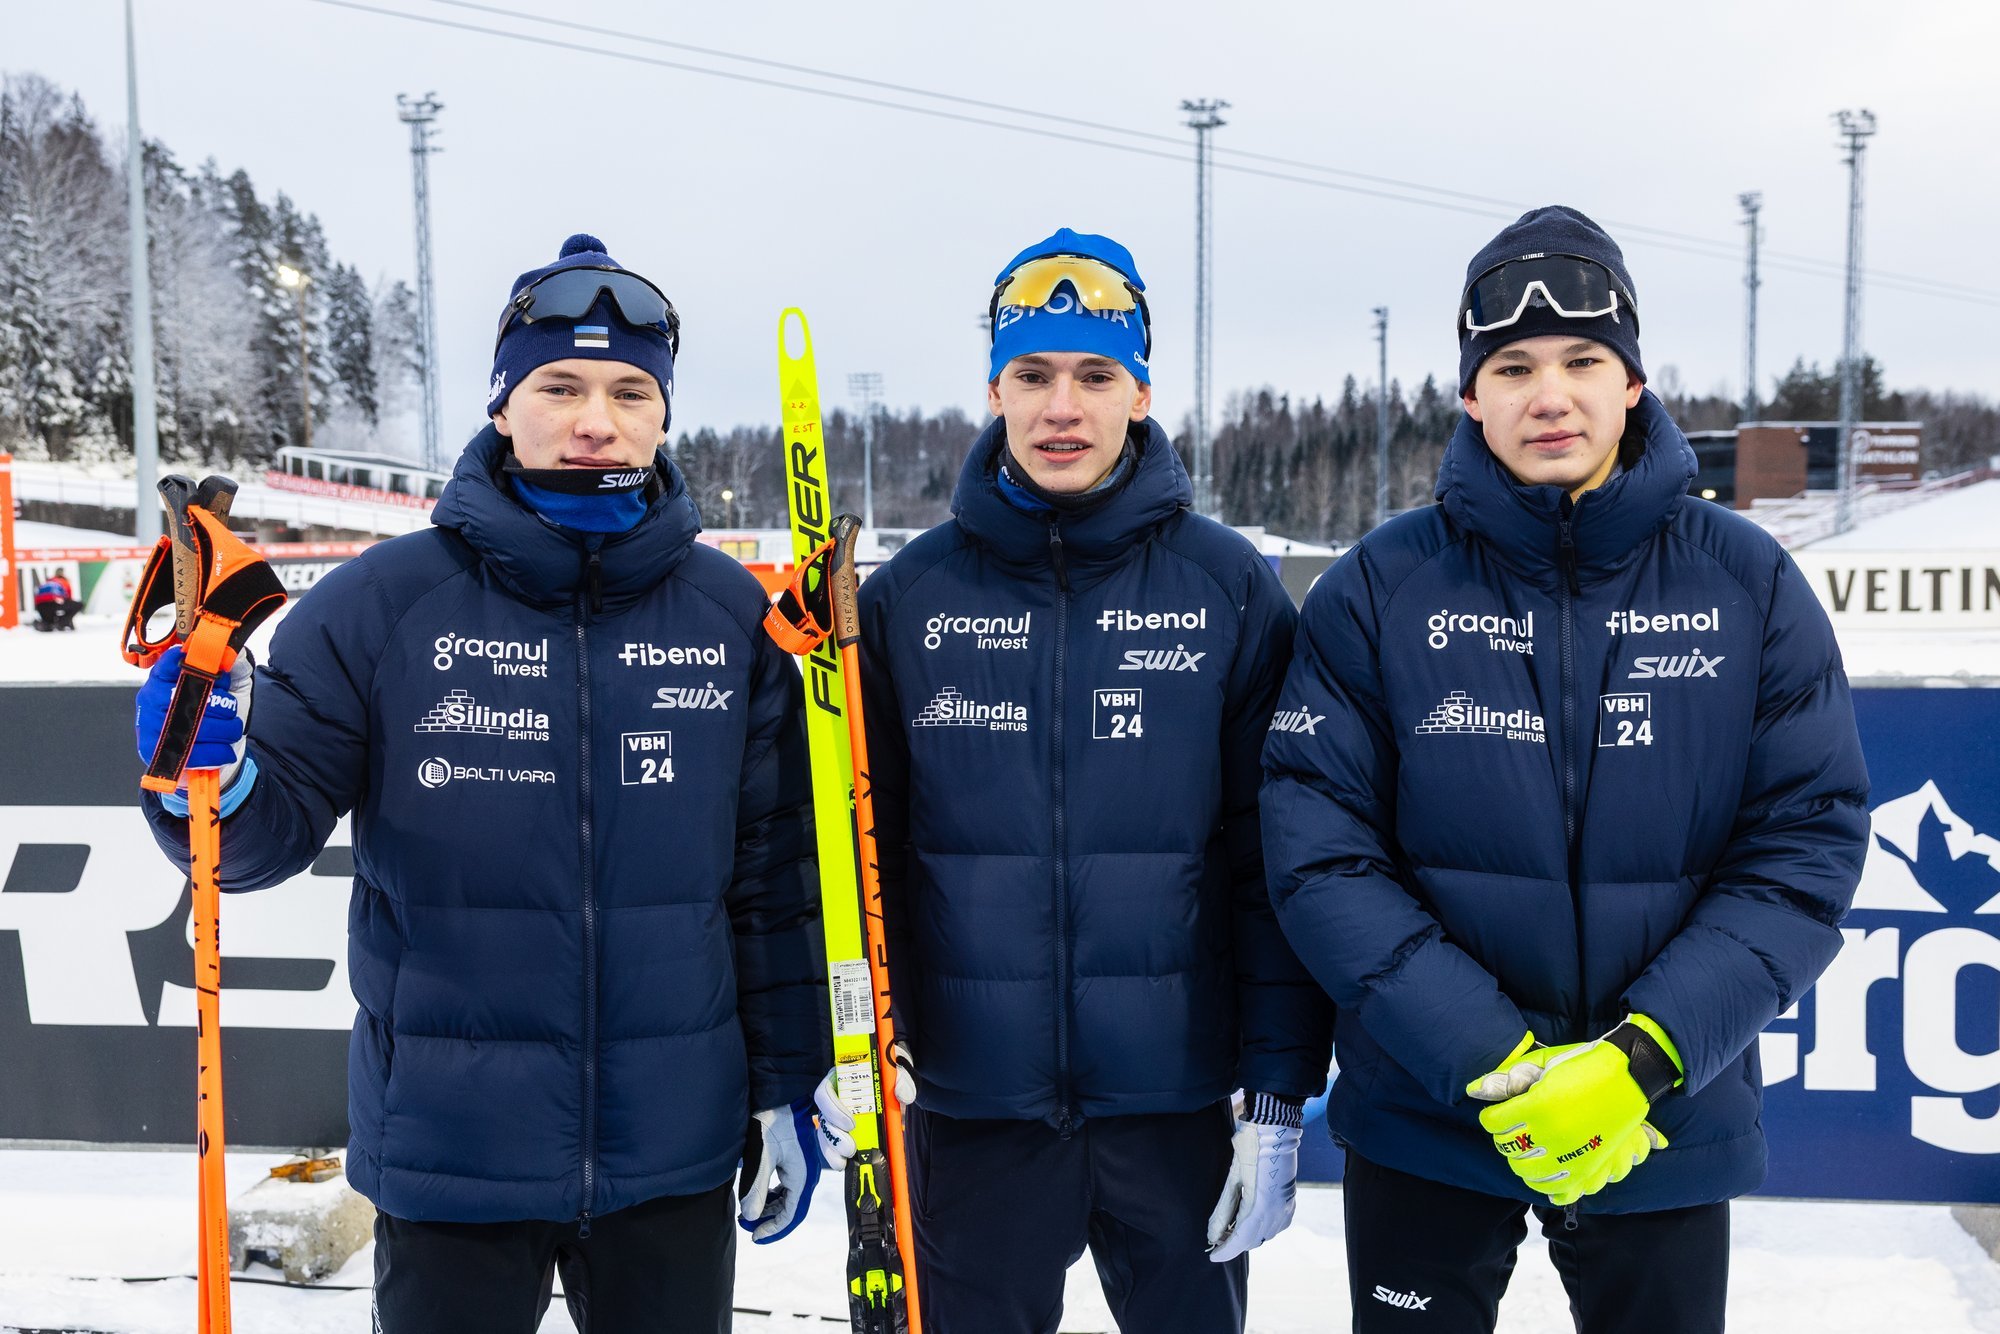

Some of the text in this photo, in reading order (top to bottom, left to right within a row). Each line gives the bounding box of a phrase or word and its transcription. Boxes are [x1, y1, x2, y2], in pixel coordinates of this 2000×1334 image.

[923, 611, 1031, 650] graanul
[1427, 609, 1534, 650] graanul
[433, 632, 548, 671] graanul
[977, 635, 1028, 650] invest
[1488, 634, 1534, 655] invest
[492, 659, 548, 678] invest
[938, 700, 1028, 721] Silindia
[1099, 693, 1136, 707] VBH
[1604, 698, 1645, 713] VBH
[446, 703, 550, 730] Silindia
[989, 721, 1028, 732] EHITUS
[1110, 713, 1144, 739] 24
[1446, 704, 1545, 732] Silindia
[507, 730, 550, 741] EHITUS
[1506, 729, 1546, 744] EHITUS
[1616, 719, 1654, 747] 24
[627, 736, 666, 752] VBH
[453, 766, 556, 784] BALTI VARA
[640, 757, 675, 785] 24
[1556, 1134, 1604, 1165] KINETIXX
